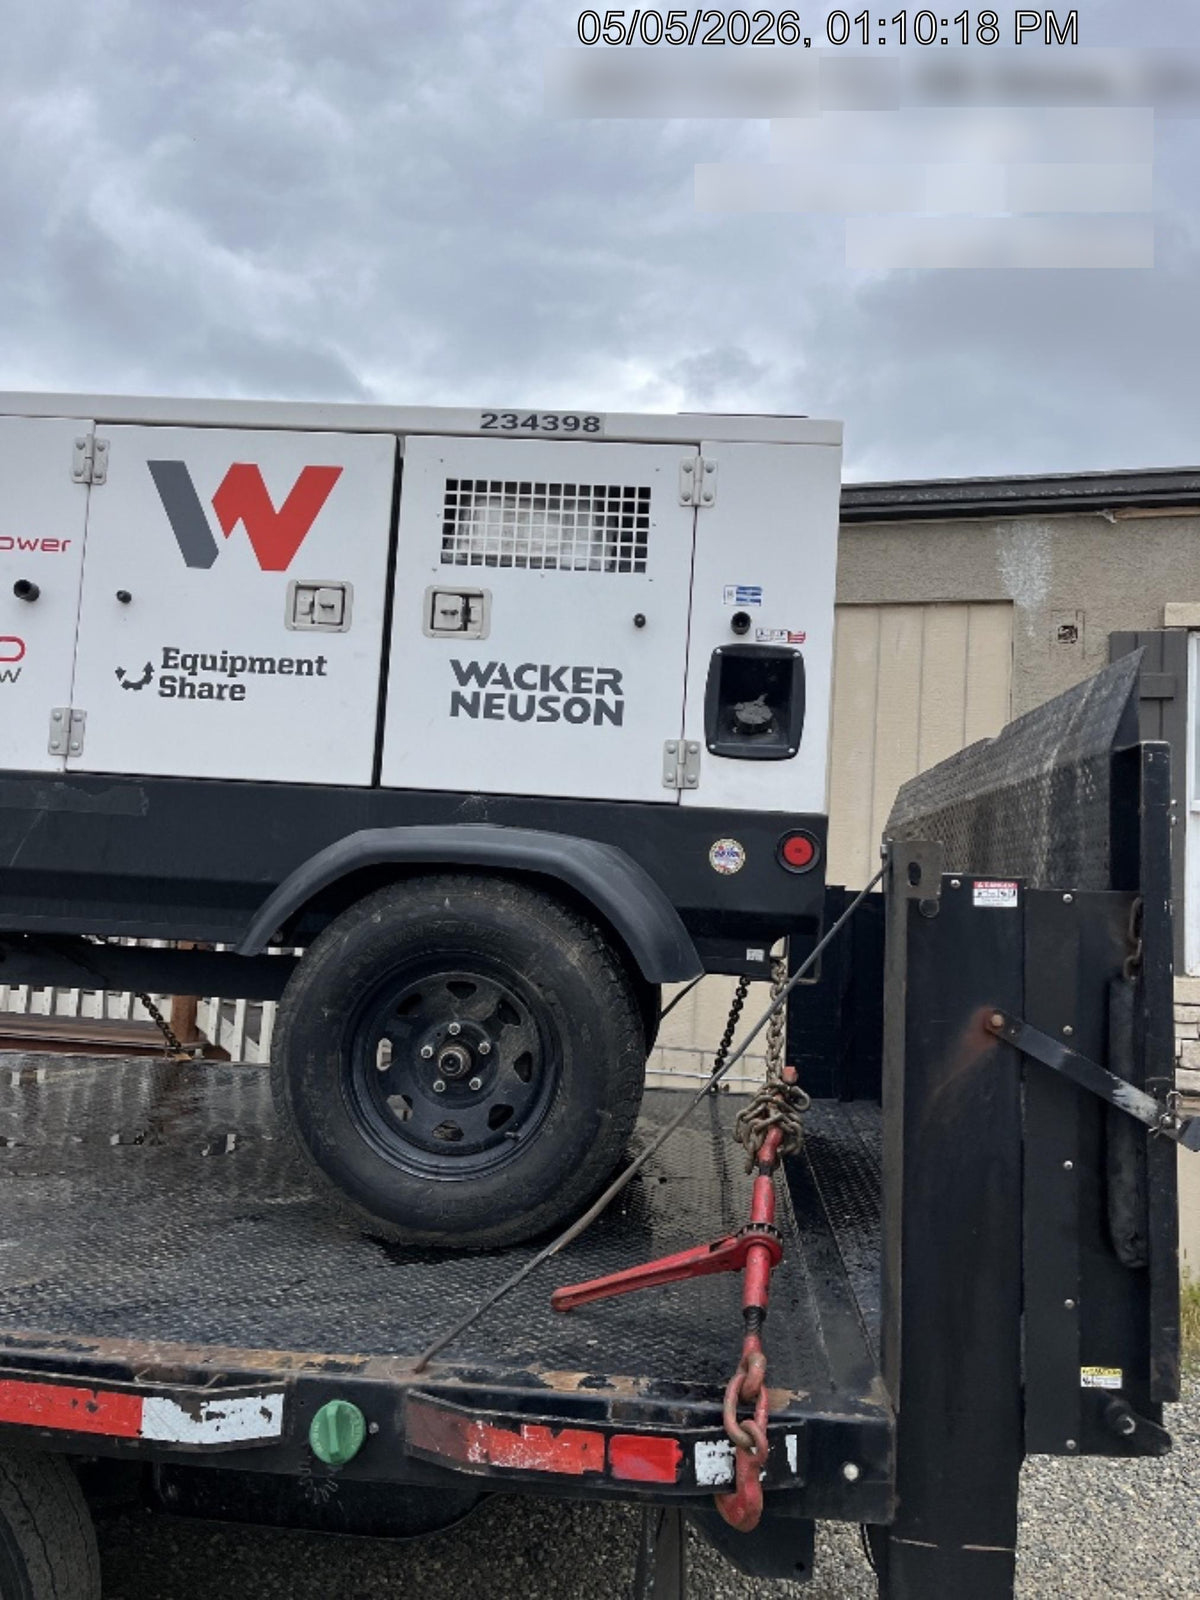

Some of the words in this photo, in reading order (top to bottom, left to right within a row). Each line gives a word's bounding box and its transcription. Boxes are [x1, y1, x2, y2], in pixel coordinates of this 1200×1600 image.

[480, 412, 600, 433] 234398
[161, 646, 328, 678] Equipment
[449, 659, 624, 696] WACKER
[158, 675, 246, 701] Share
[450, 691, 625, 727] NEUSON
